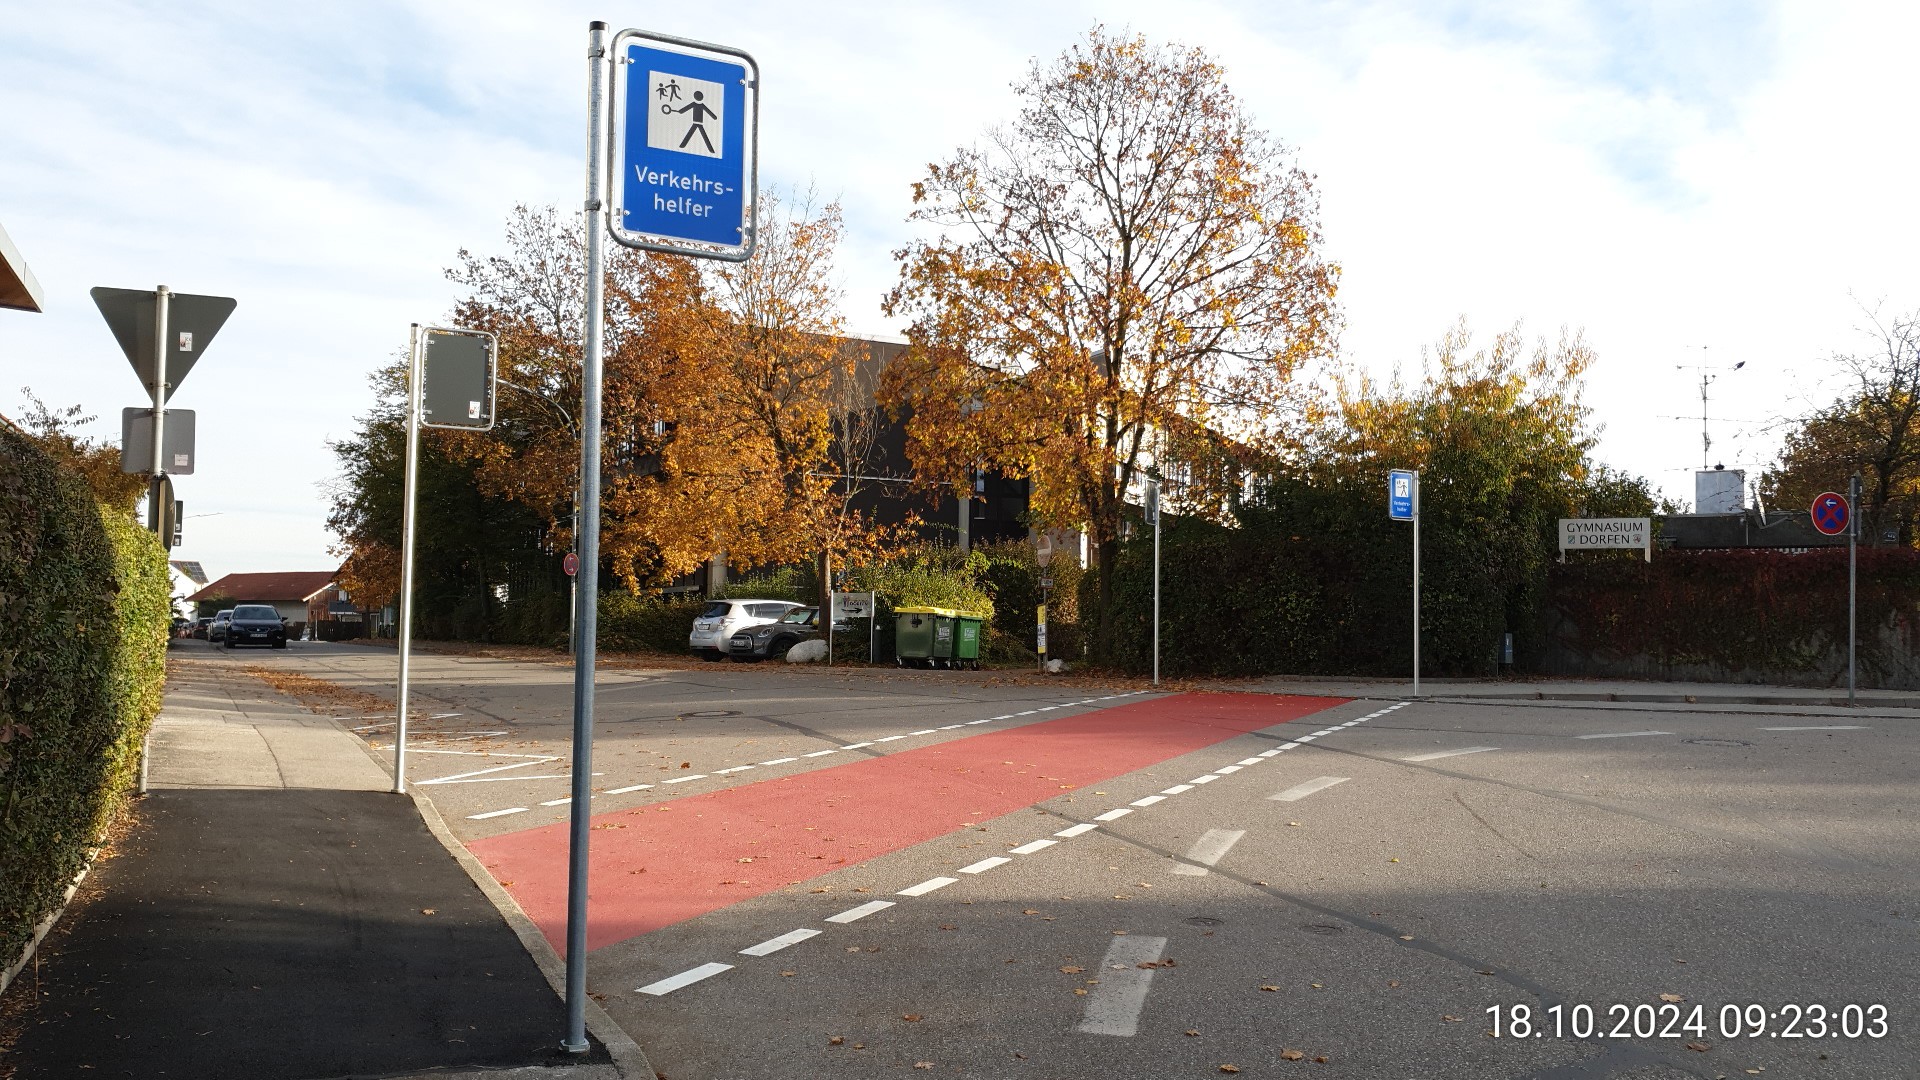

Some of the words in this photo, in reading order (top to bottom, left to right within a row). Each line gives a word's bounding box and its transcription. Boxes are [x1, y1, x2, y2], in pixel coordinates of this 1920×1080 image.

[634, 164, 734, 196] Verkehrs-
[653, 193, 713, 218] helfer
[1566, 522, 1643, 533] GYMNASIUM
[1579, 534, 1630, 545] DORFEN
